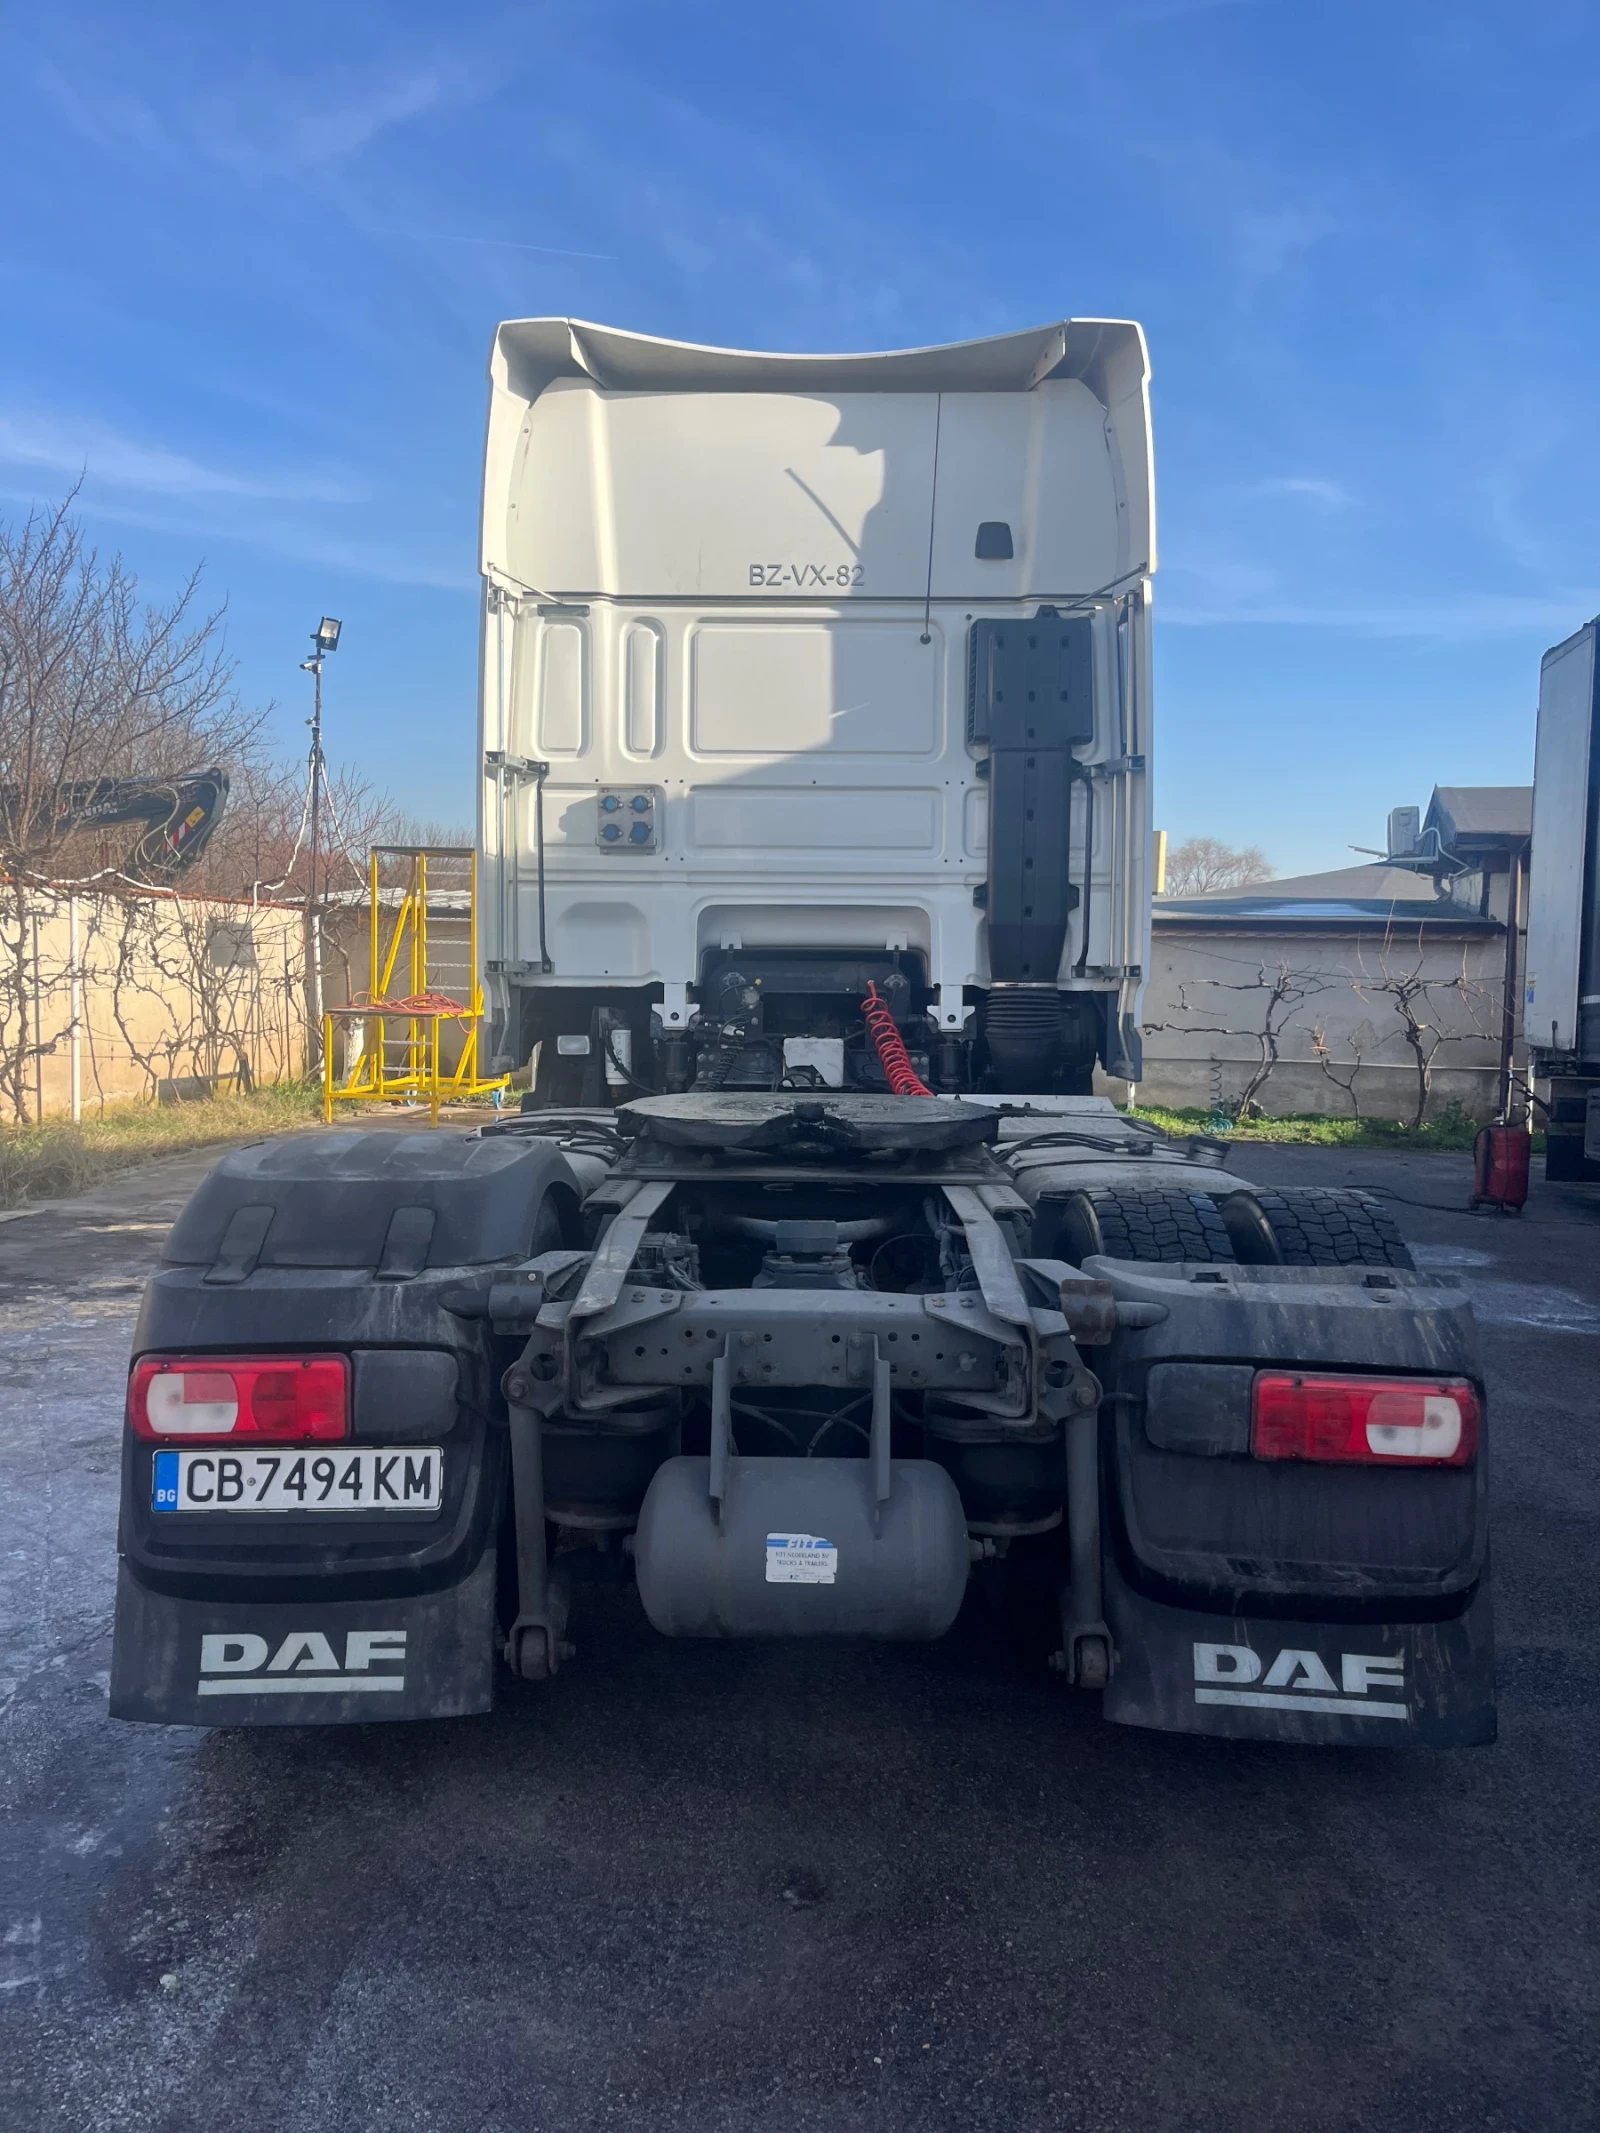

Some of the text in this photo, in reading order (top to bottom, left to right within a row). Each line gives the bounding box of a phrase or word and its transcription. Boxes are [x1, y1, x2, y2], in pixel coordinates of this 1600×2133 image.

[749, 564, 865, 586] BZ-VX-82
[157, 1489, 176, 1502] BG
[186, 1455, 432, 1502] CB 7494 KM
[200, 1630, 407, 1672] DAF
[1193, 1642, 1404, 1693] DAF
